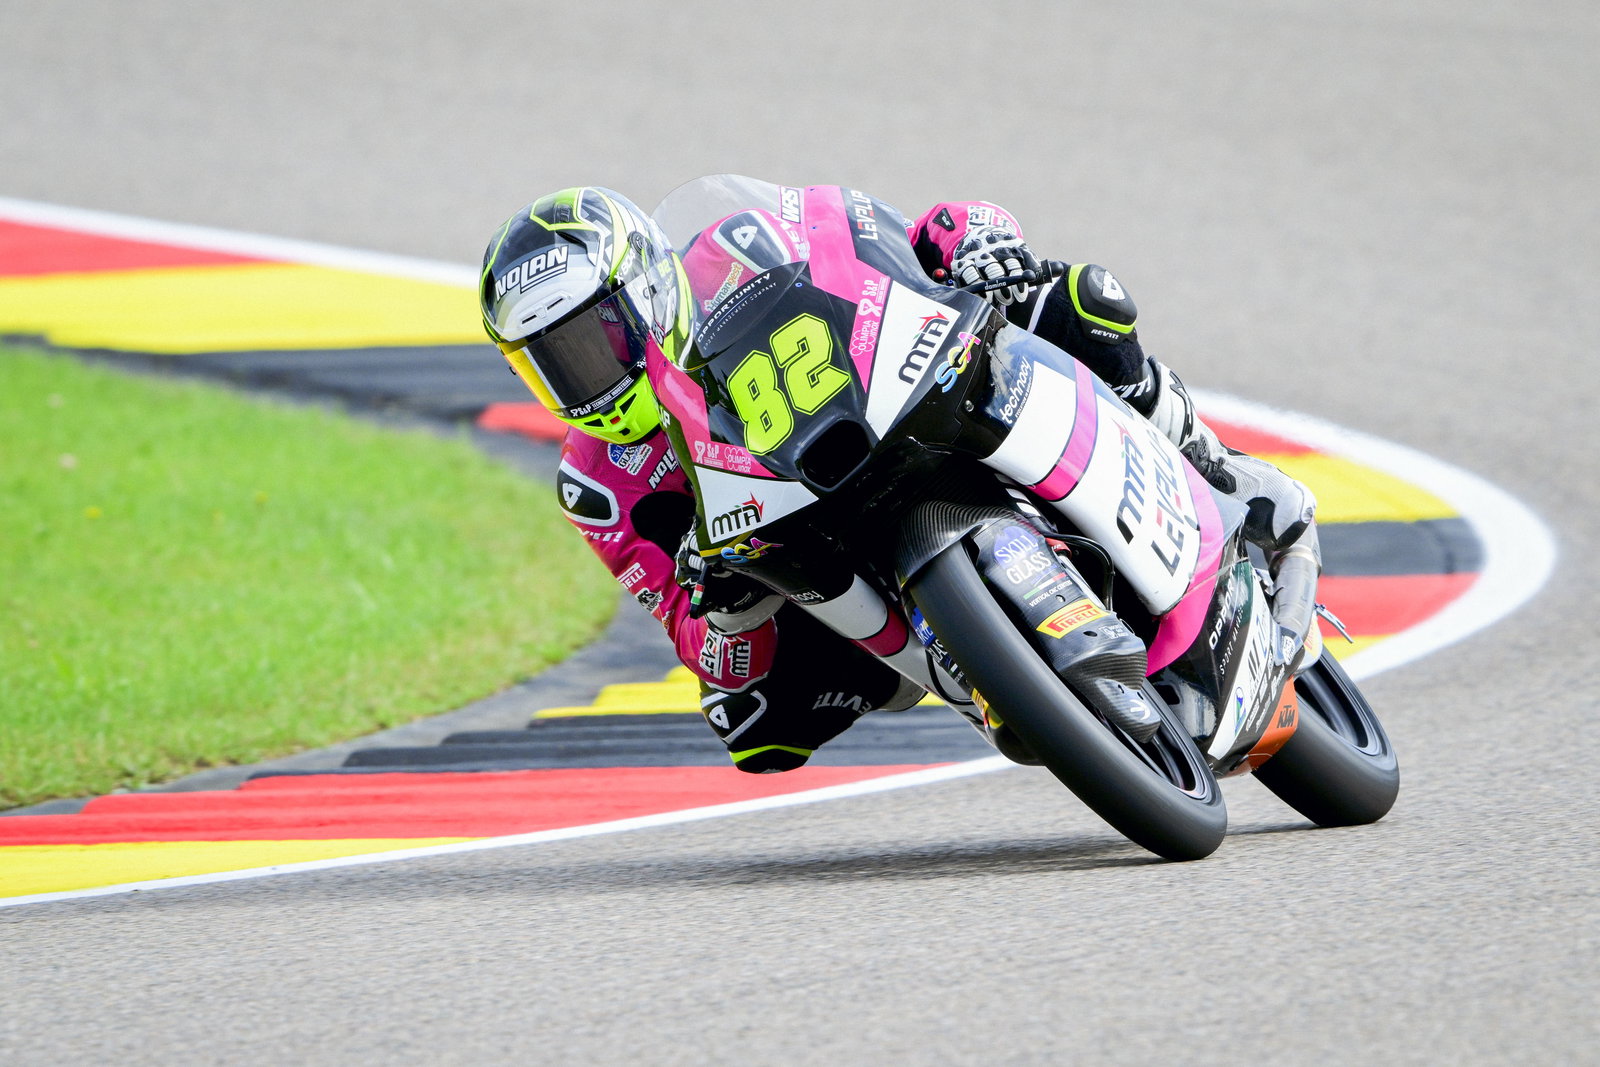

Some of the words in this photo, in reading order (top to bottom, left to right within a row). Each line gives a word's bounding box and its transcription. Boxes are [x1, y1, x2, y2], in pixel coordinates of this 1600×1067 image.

[495, 245, 568, 304] NOLAN
[697, 272, 771, 343] OPPORTUNITY
[858, 320, 872, 351] OLIMPIA
[898, 317, 950, 386] MTA
[727, 312, 850, 456] 82
[649, 447, 678, 490] NOL
[1117, 435, 1145, 545] MTA
[711, 504, 762, 538] MTA
[994, 535, 1039, 564] SKILL
[1006, 551, 1052, 585] GLASS
[1047, 604, 1101, 633] PIRELLI
[731, 640, 749, 677] MTA
[1277, 704, 1296, 729] KTM
